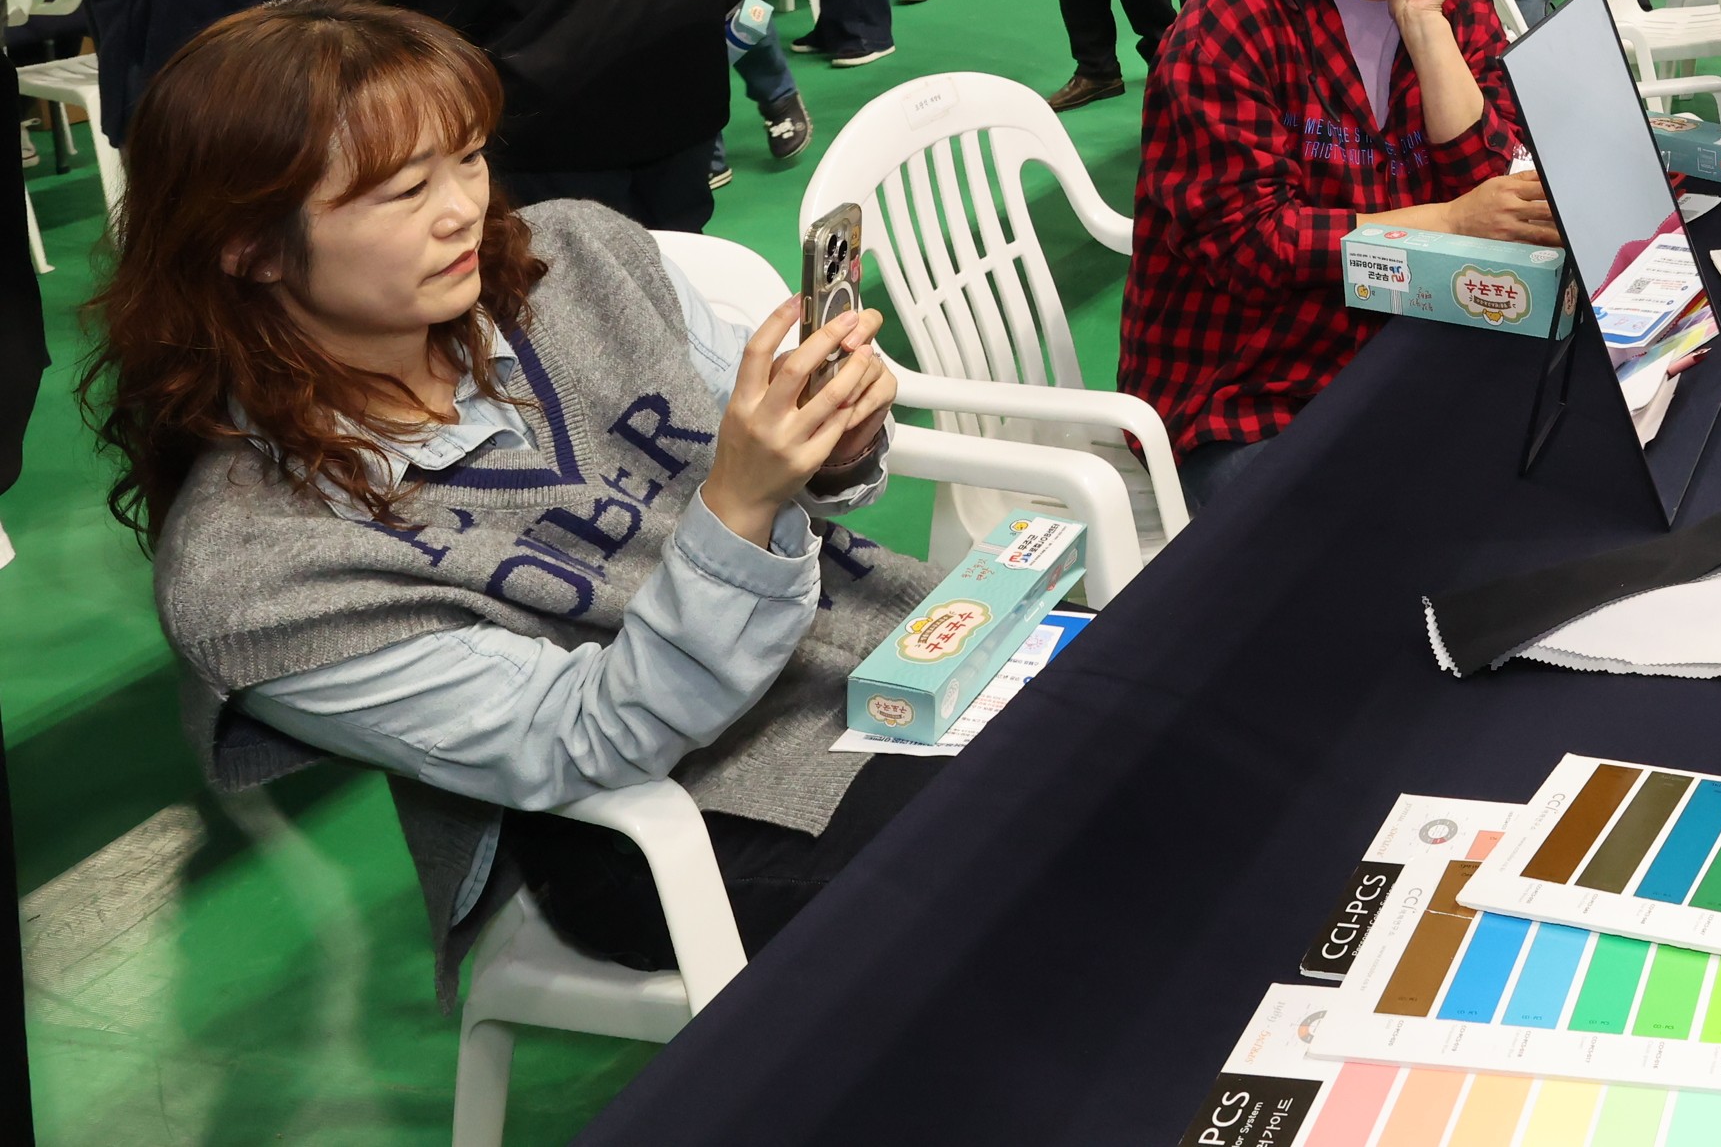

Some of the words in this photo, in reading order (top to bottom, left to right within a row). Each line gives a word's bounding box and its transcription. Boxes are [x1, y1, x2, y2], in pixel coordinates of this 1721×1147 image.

[1368, 270, 1390, 282] 무주군
[1464, 280, 1519, 300] 구포국수
[1017, 533, 1038, 554] 무주군
[926, 610, 975, 654] 구포국수
[1321, 872, 1389, 962] CCI-PCS
[1200, 1091, 1251, 1147] PCS
[1237, 1101, 1265, 1136] System
[1257, 1096, 1296, 1147] 러가이드
